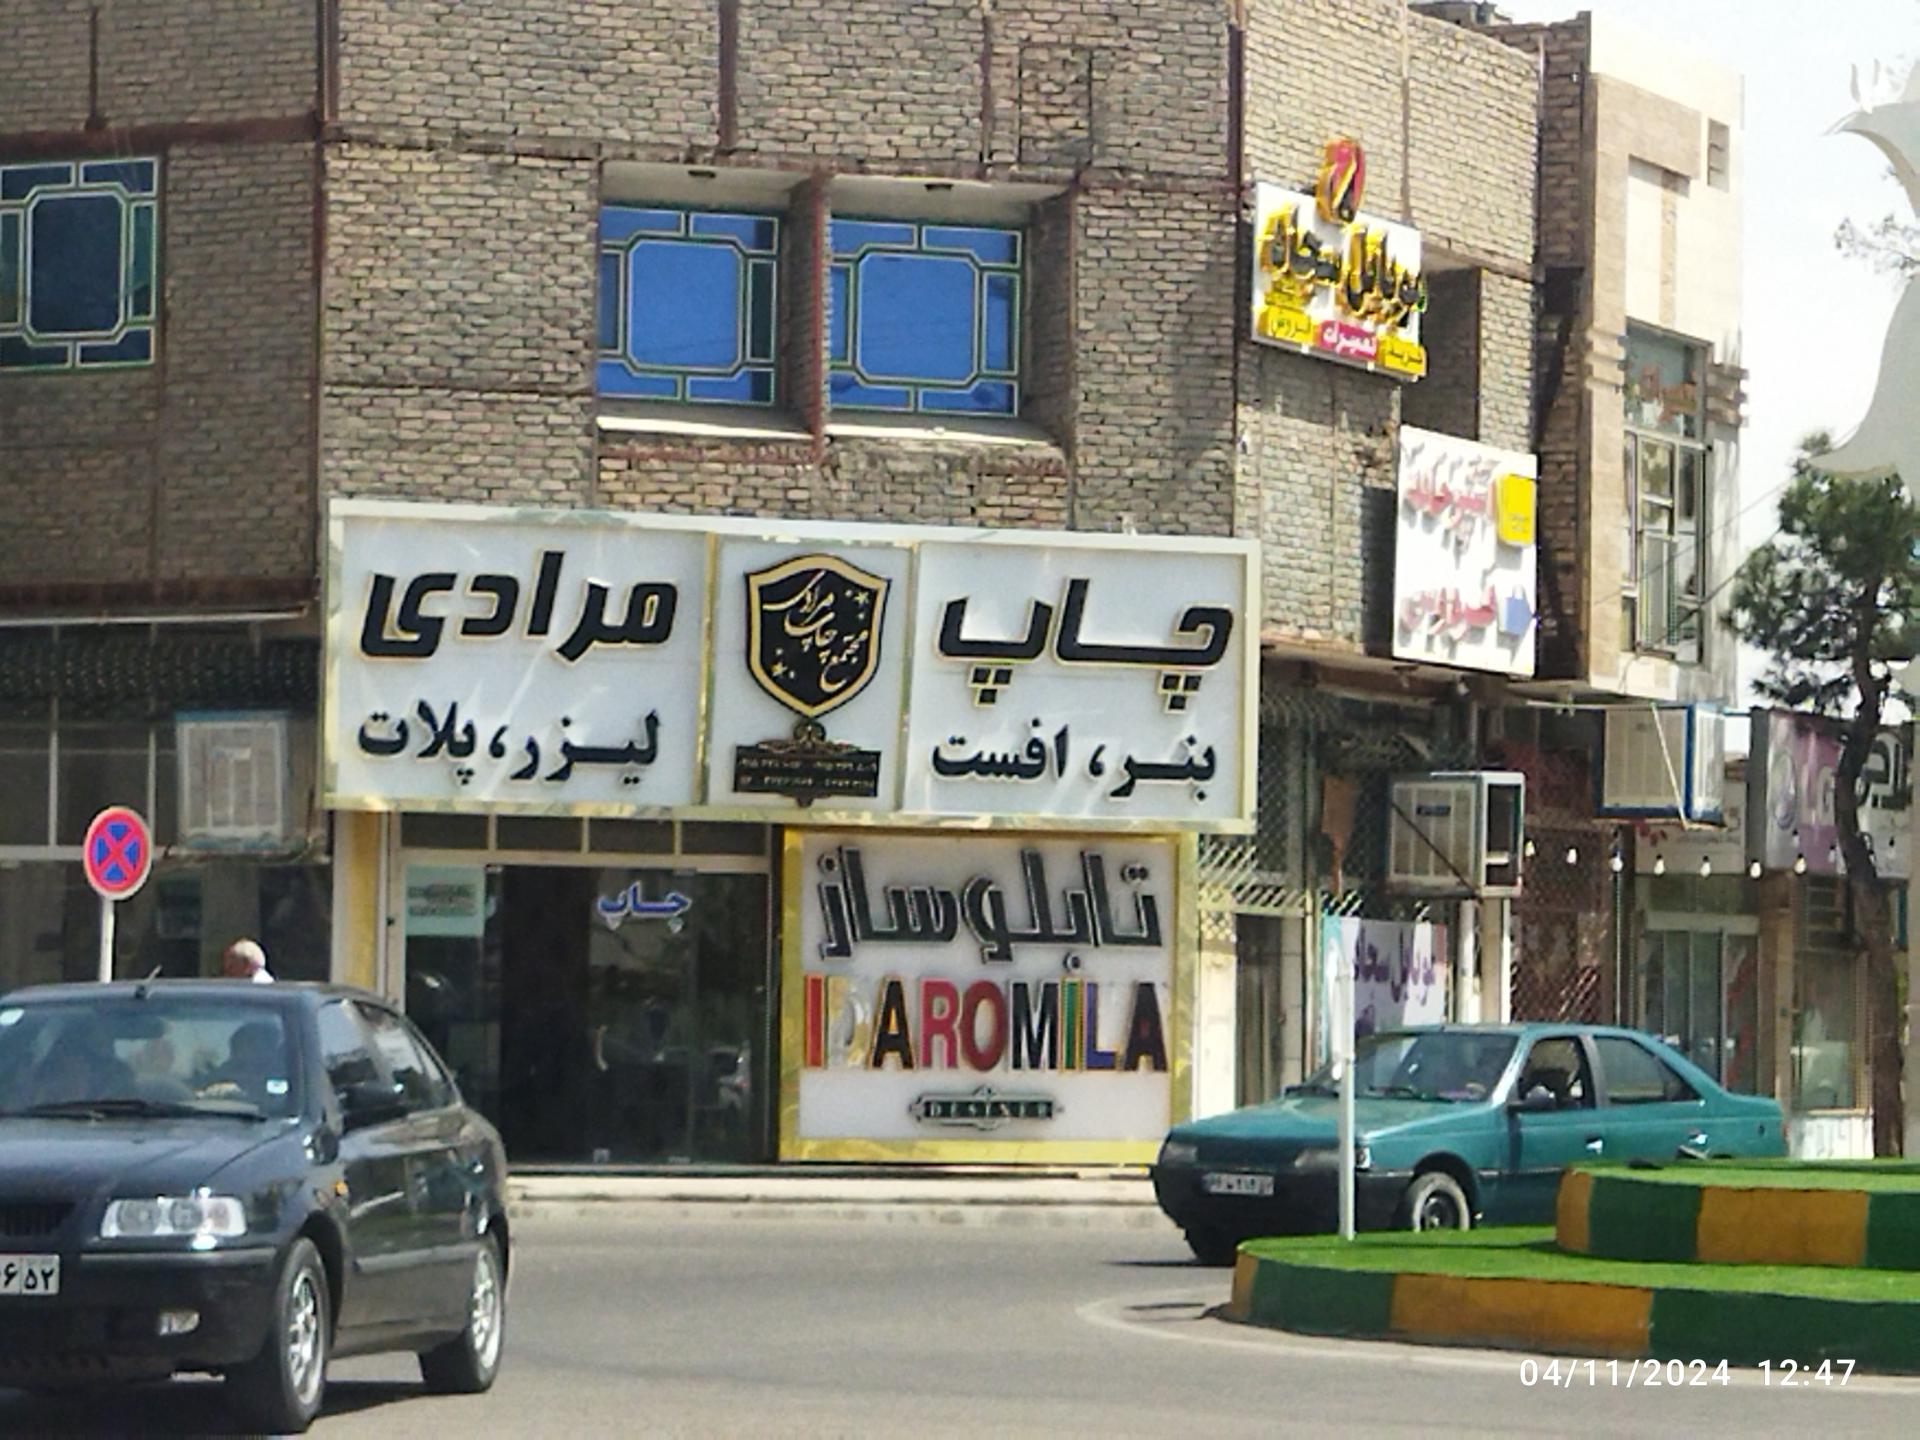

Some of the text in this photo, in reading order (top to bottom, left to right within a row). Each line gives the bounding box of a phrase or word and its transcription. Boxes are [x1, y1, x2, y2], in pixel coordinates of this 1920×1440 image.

[360, 550, 678, 662] مرادی
[938, 577, 1234, 711] چاپ
[931, 717, 1070, 780] افست
